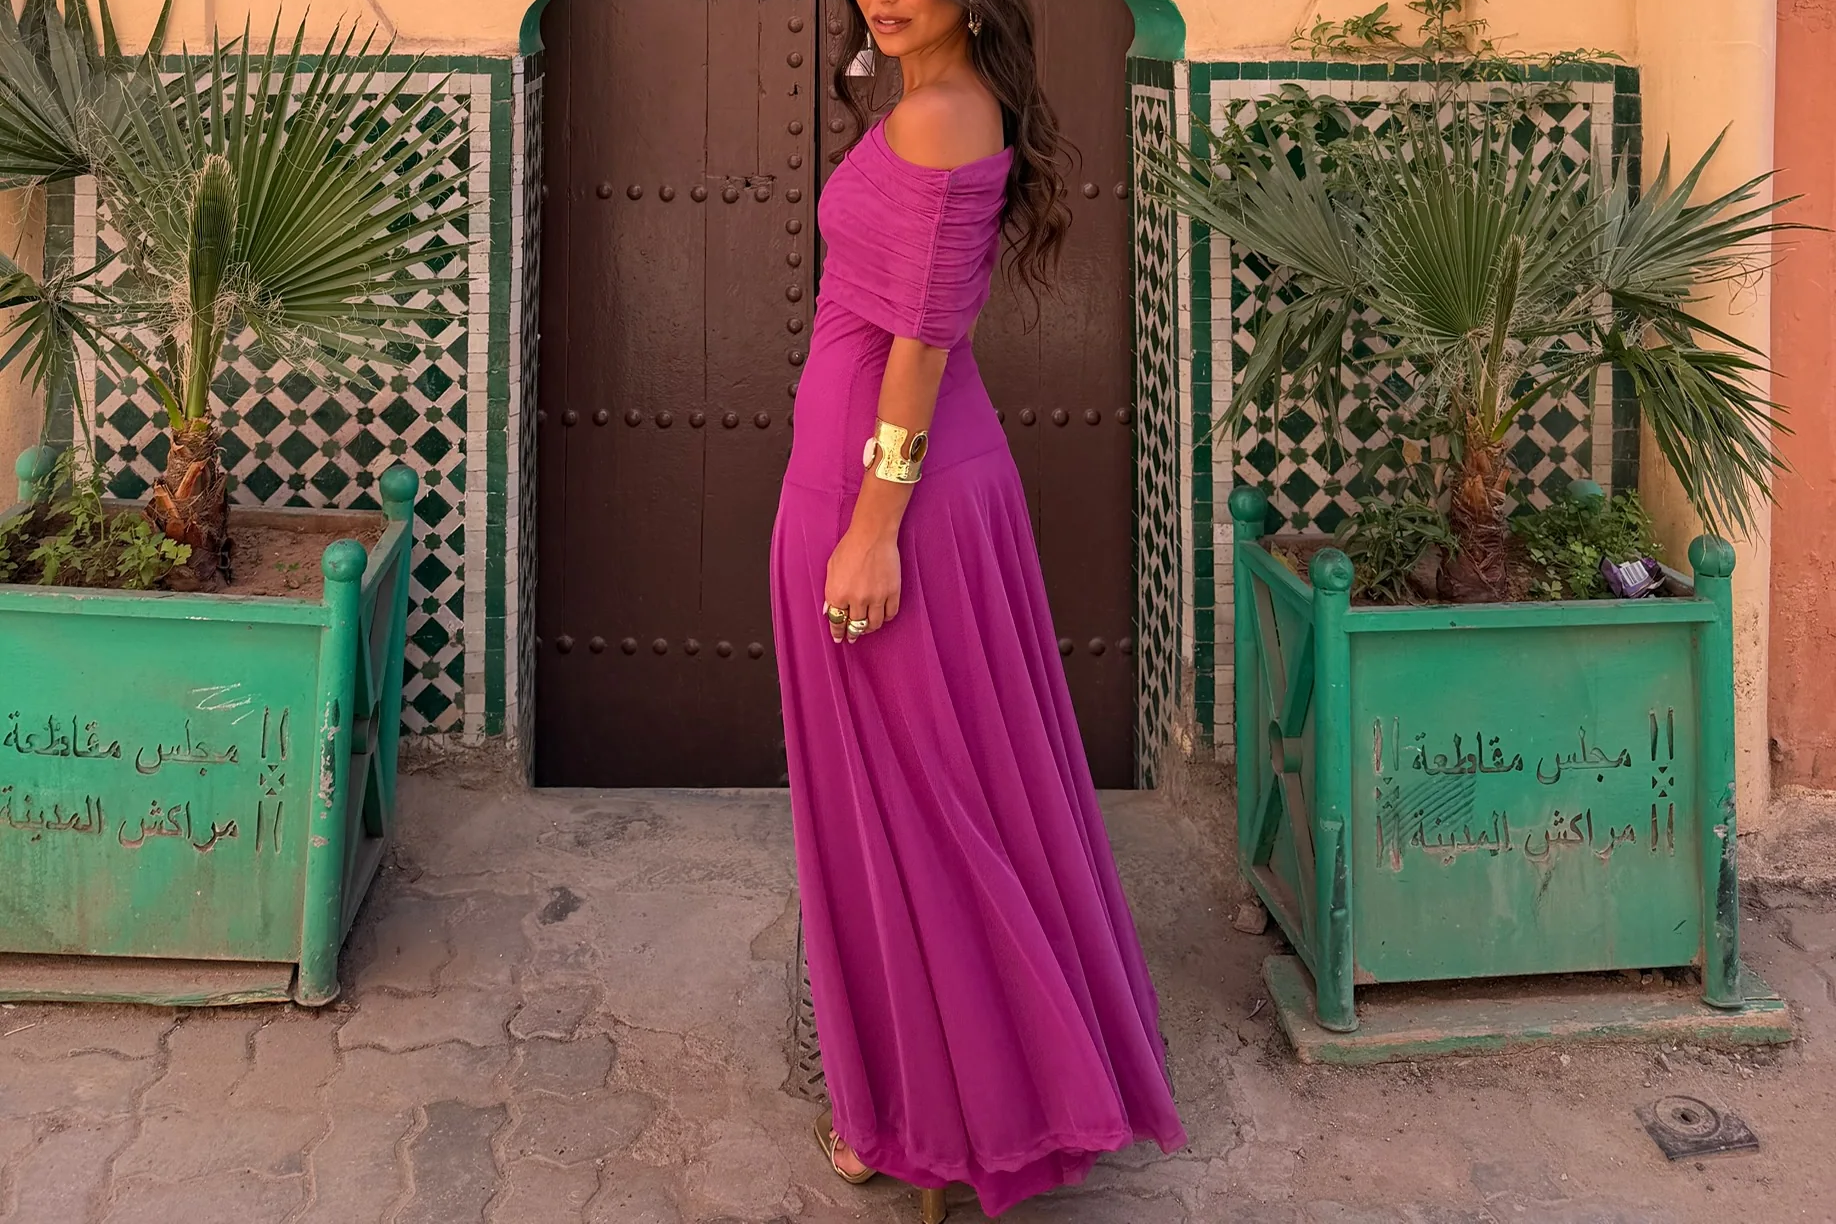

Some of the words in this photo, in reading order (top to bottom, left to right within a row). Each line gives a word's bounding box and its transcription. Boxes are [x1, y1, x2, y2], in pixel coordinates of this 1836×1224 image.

[3, 710, 121, 759] مقاطعة
[136, 719, 239, 775] مجلس
[1412, 731, 1523, 776] مقاطعة
[1536, 726, 1632, 785] مجلس
[118, 799, 239, 853] مراكش
[1411, 809, 1513, 865] المدينة
[1524, 808, 1636, 863] مراكش
